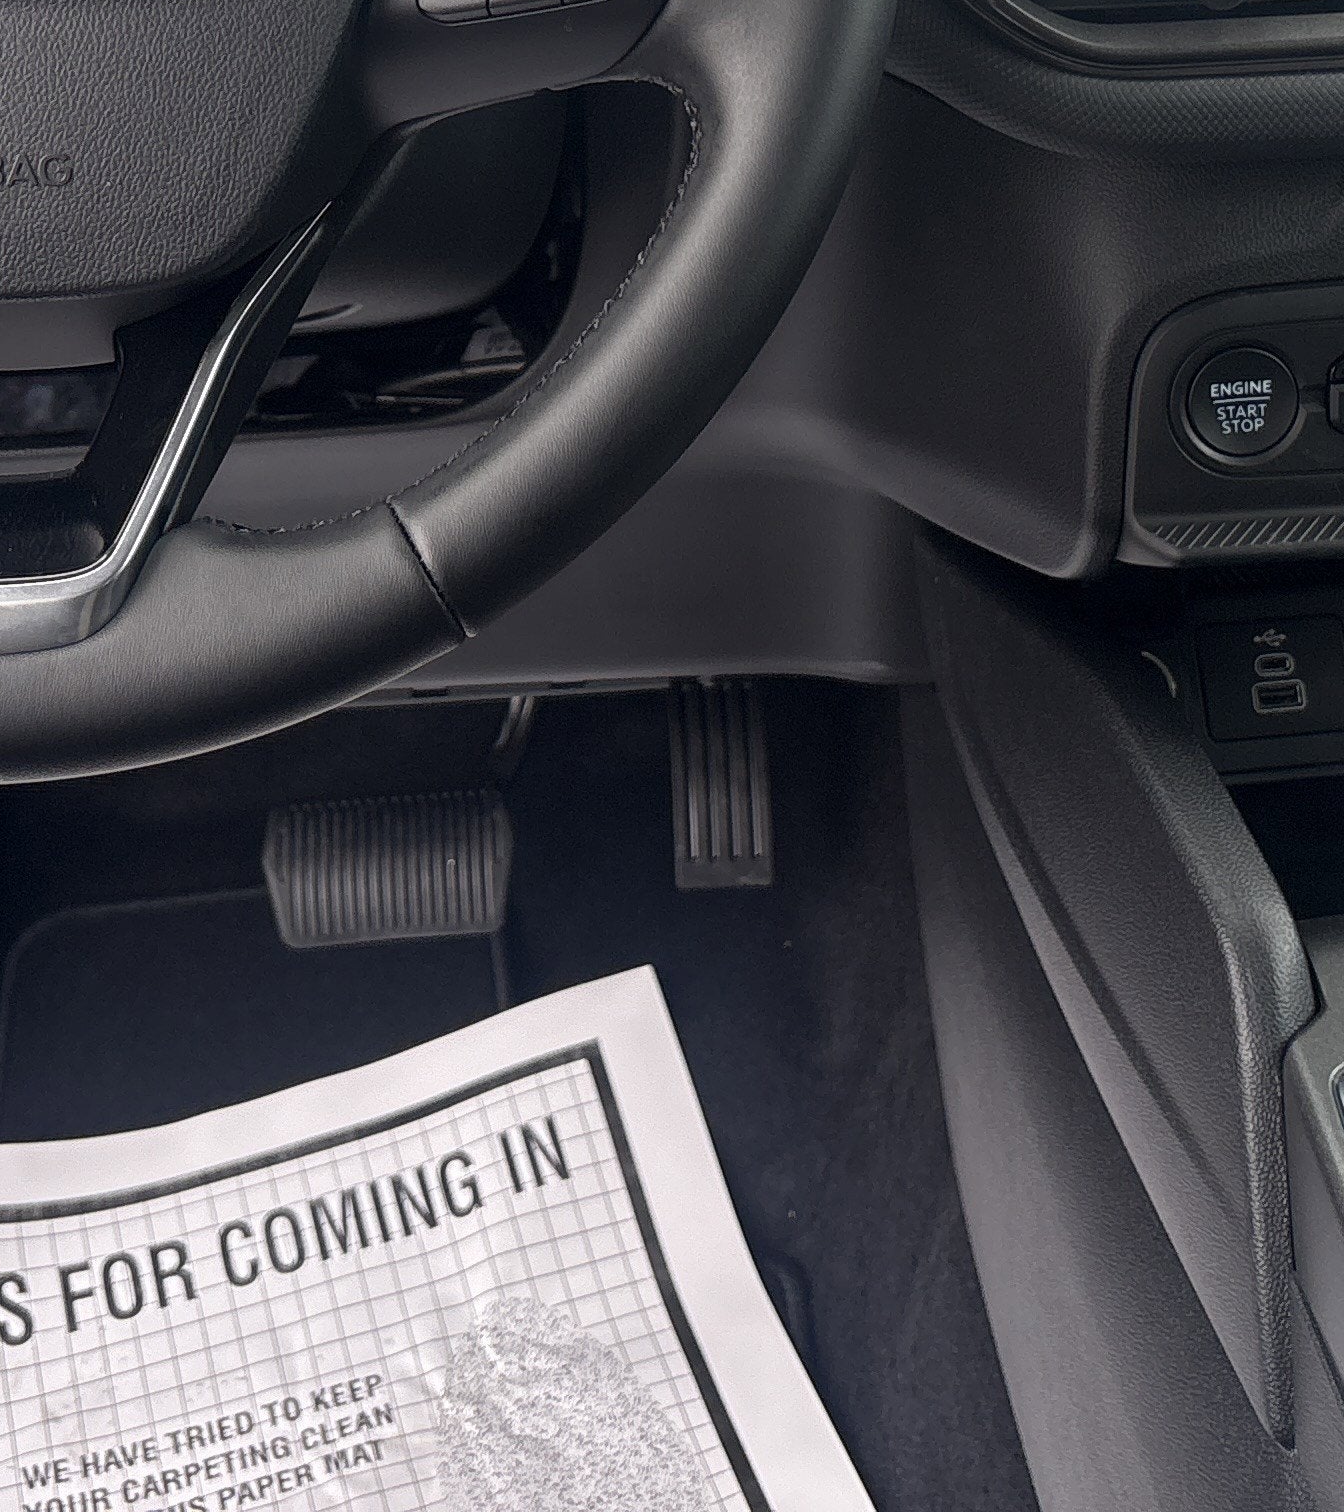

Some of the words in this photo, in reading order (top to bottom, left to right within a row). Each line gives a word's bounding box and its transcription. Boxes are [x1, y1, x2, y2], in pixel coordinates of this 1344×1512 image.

[1210, 379, 1273, 398] ENGINE
[1216, 403, 1268, 421] START
[1221, 417, 1265, 435] STOP
[59, 1240, 198, 1333] FOR
[218, 1150, 484, 1287] COMING
[500, 1113, 572, 1194] IN
[21, 1457, 71, 1490] WE
[80, 1438, 157, 1479] HAVE
[164, 1410, 254, 1455] TRIED
[261, 1396, 302, 1427] TO
[309, 1373, 382, 1413] KEEP
[120, 1436, 291, 1504] CARPETING
[300, 1402, 394, 1452] CLEAN
[217, 1463, 316, 1511] PAPER
[323, 1439, 384, 1475] MAT
